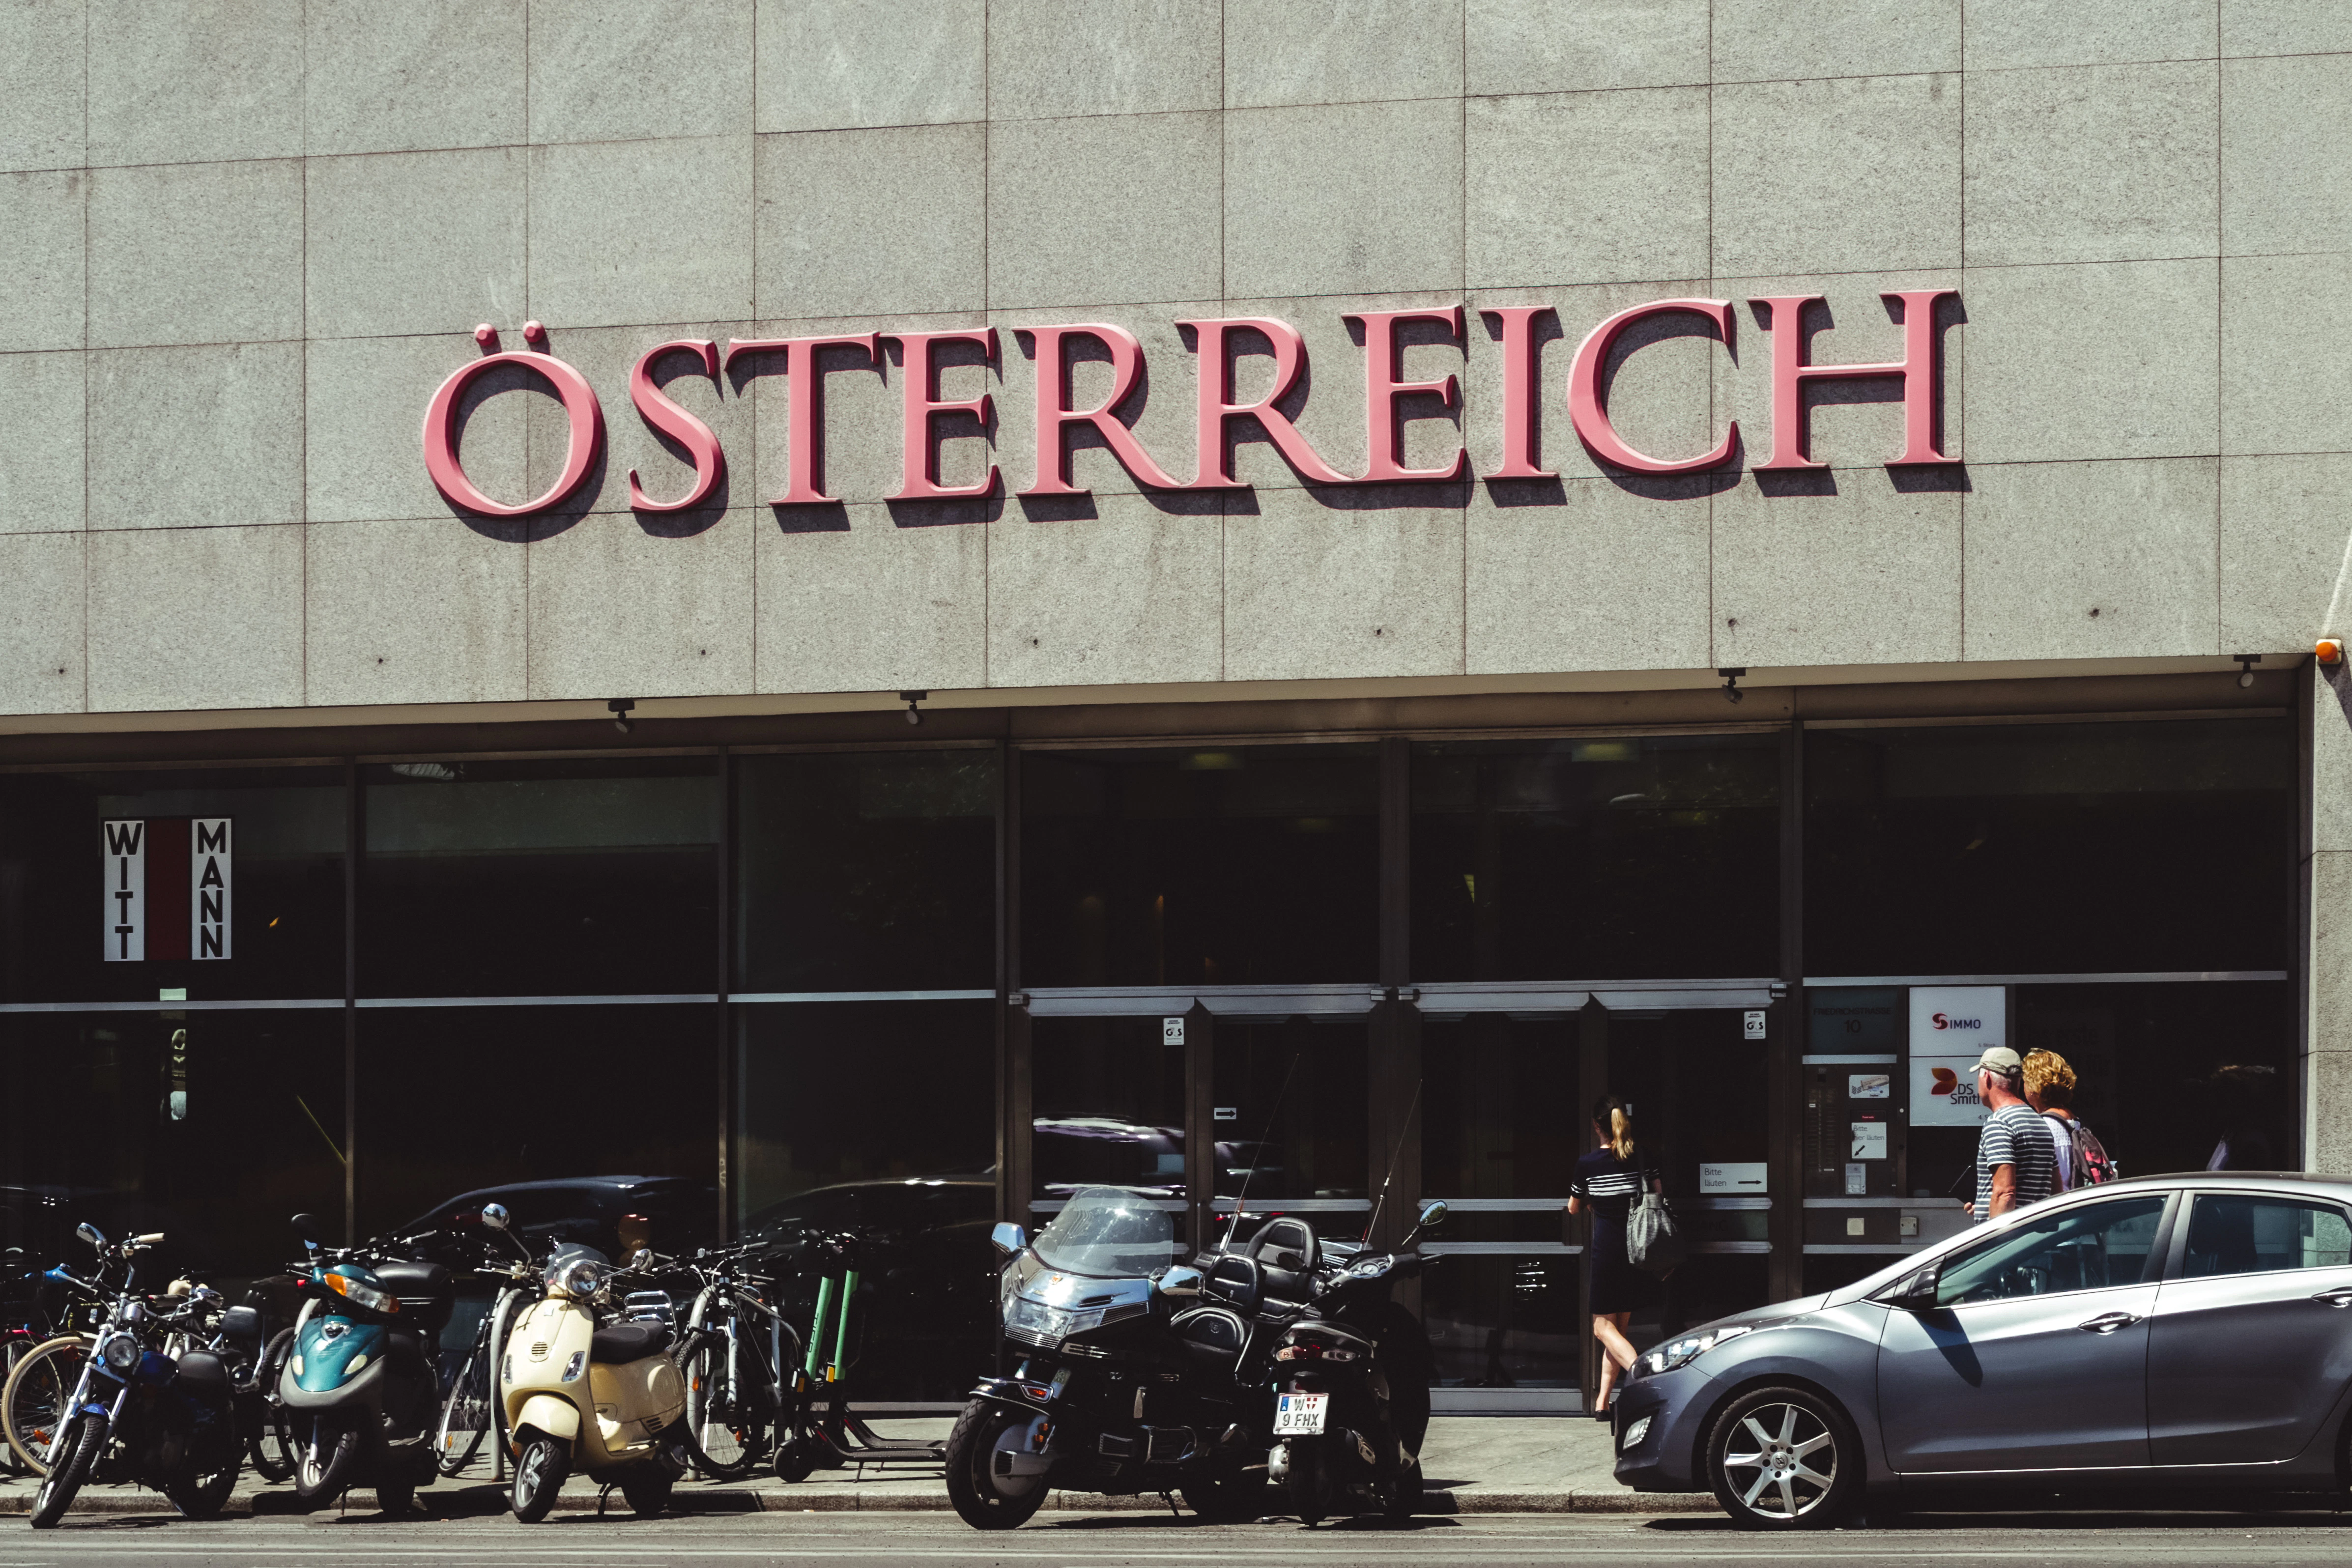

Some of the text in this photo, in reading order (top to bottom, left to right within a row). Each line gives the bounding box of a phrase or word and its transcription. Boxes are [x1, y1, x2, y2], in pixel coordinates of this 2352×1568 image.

[422, 288, 1963, 517] ÖSTERREICH
[106, 823, 143, 960] WITT
[197, 821, 226, 958] MANN
[1844, 1019, 1862, 1033] 10
[1958, 1083, 1974, 1095] DS
[1704, 1168, 1722, 1176] Bitte
[1294, 1398, 1305, 1411] W
[1282, 1414, 1319, 1426] 9 FHX
